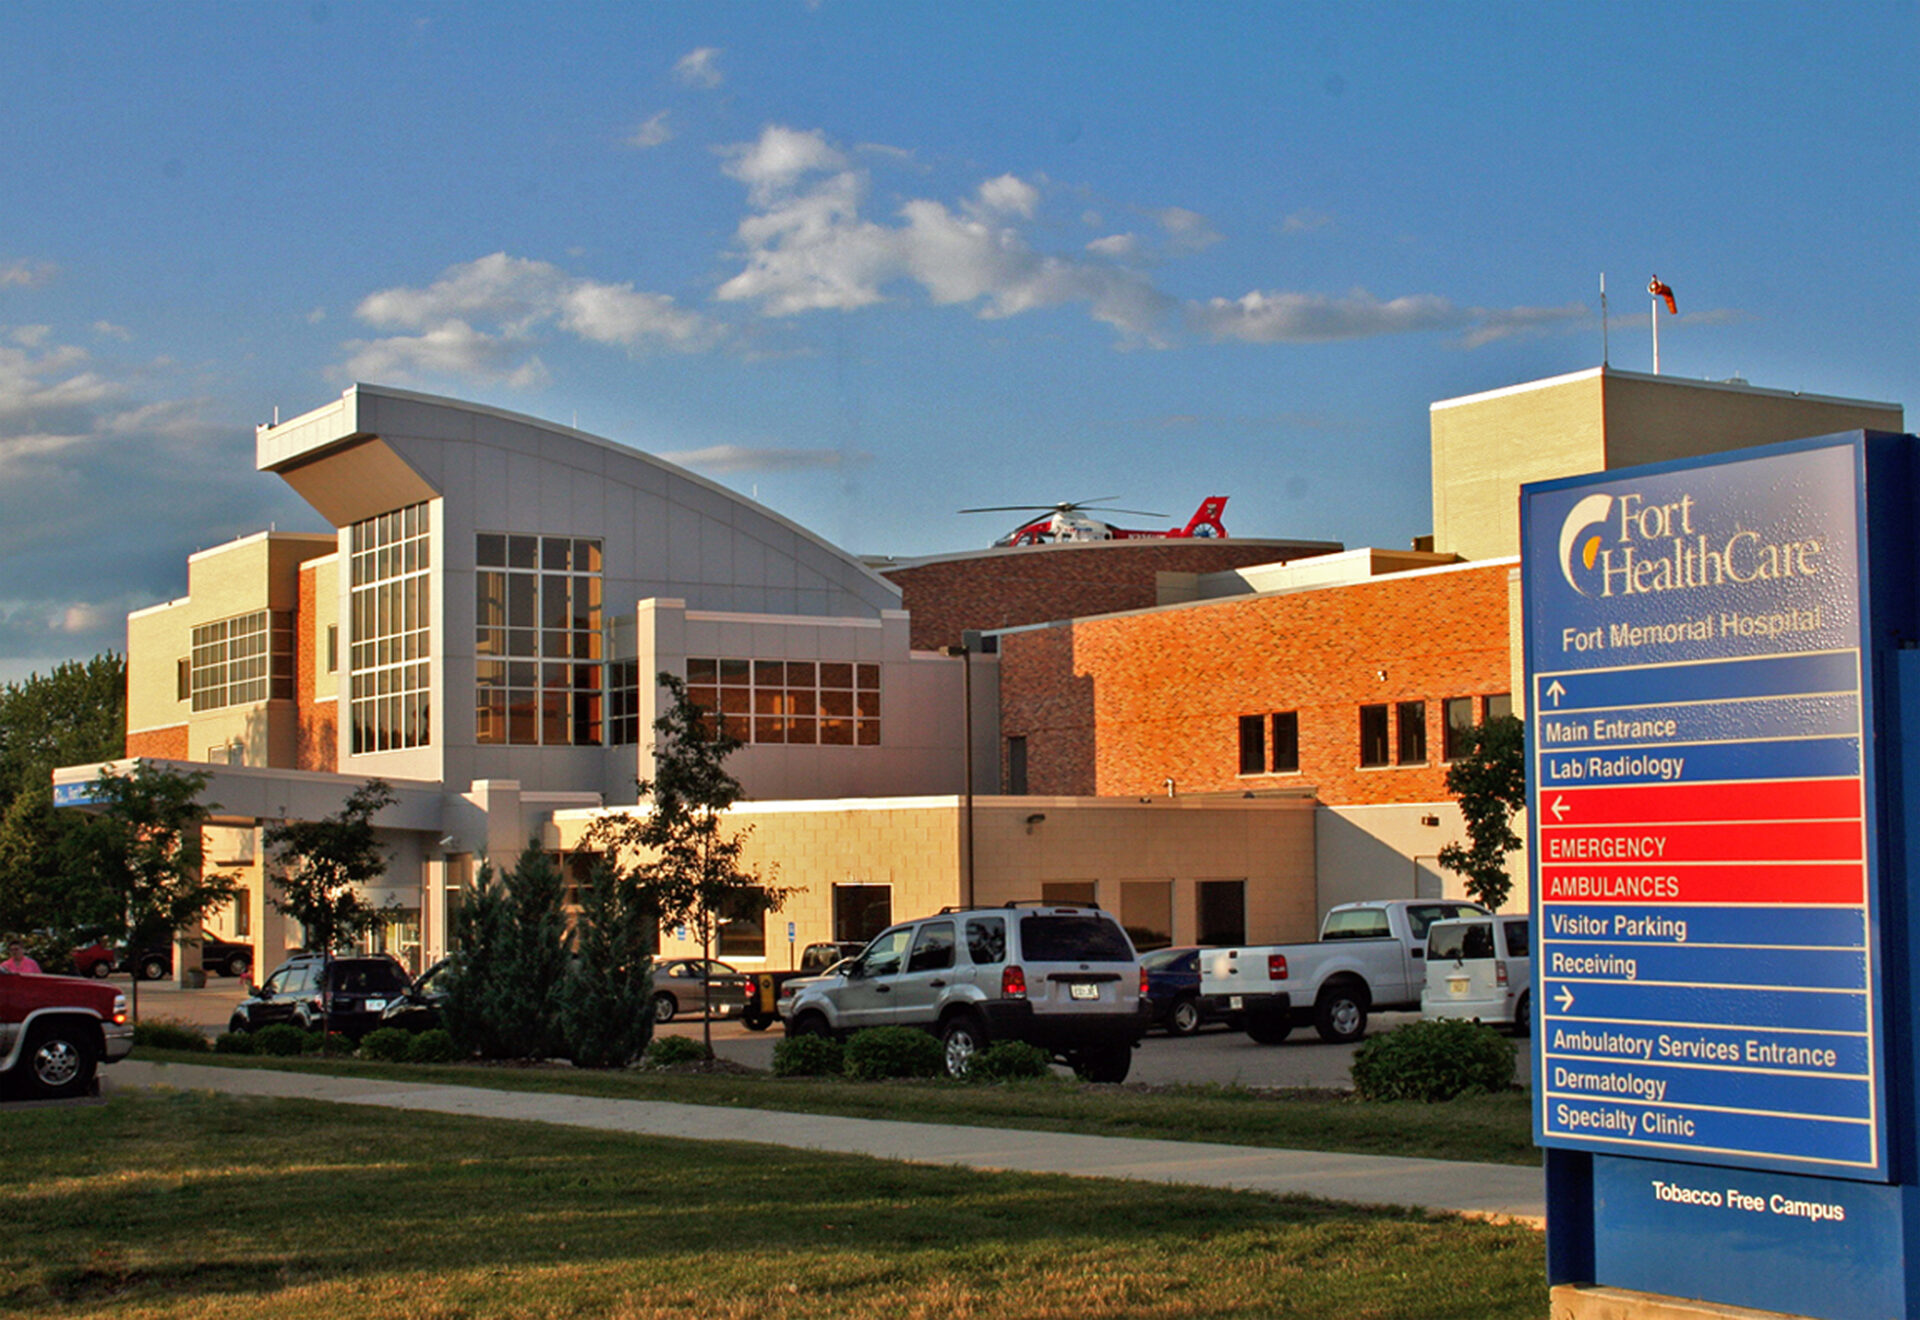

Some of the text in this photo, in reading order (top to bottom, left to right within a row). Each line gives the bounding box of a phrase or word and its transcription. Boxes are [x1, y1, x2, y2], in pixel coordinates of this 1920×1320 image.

[1618, 493, 1695, 542] Fort
[1600, 531, 1822, 597] HealthCare
[1562, 607, 1822, 652] Fort Memorial Hospital
[1546, 719, 1677, 742] Main Entrance
[1550, 756, 1684, 779] Lab/Radiology
[1550, 837, 1666, 858] EMERGENCY
[1550, 876, 1679, 896] AMBULANCES
[1551, 914, 1687, 942] Visitor Parking
[1552, 953, 1637, 979] Receiving
[1553, 1029, 1837, 1067] Ambulatory Services Entrance
[1555, 1068, 1666, 1099] Dermatology
[1557, 1105, 1695, 1136] Specialty Clinic
[1652, 1181, 1845, 1222] Tobacco Free Campus
